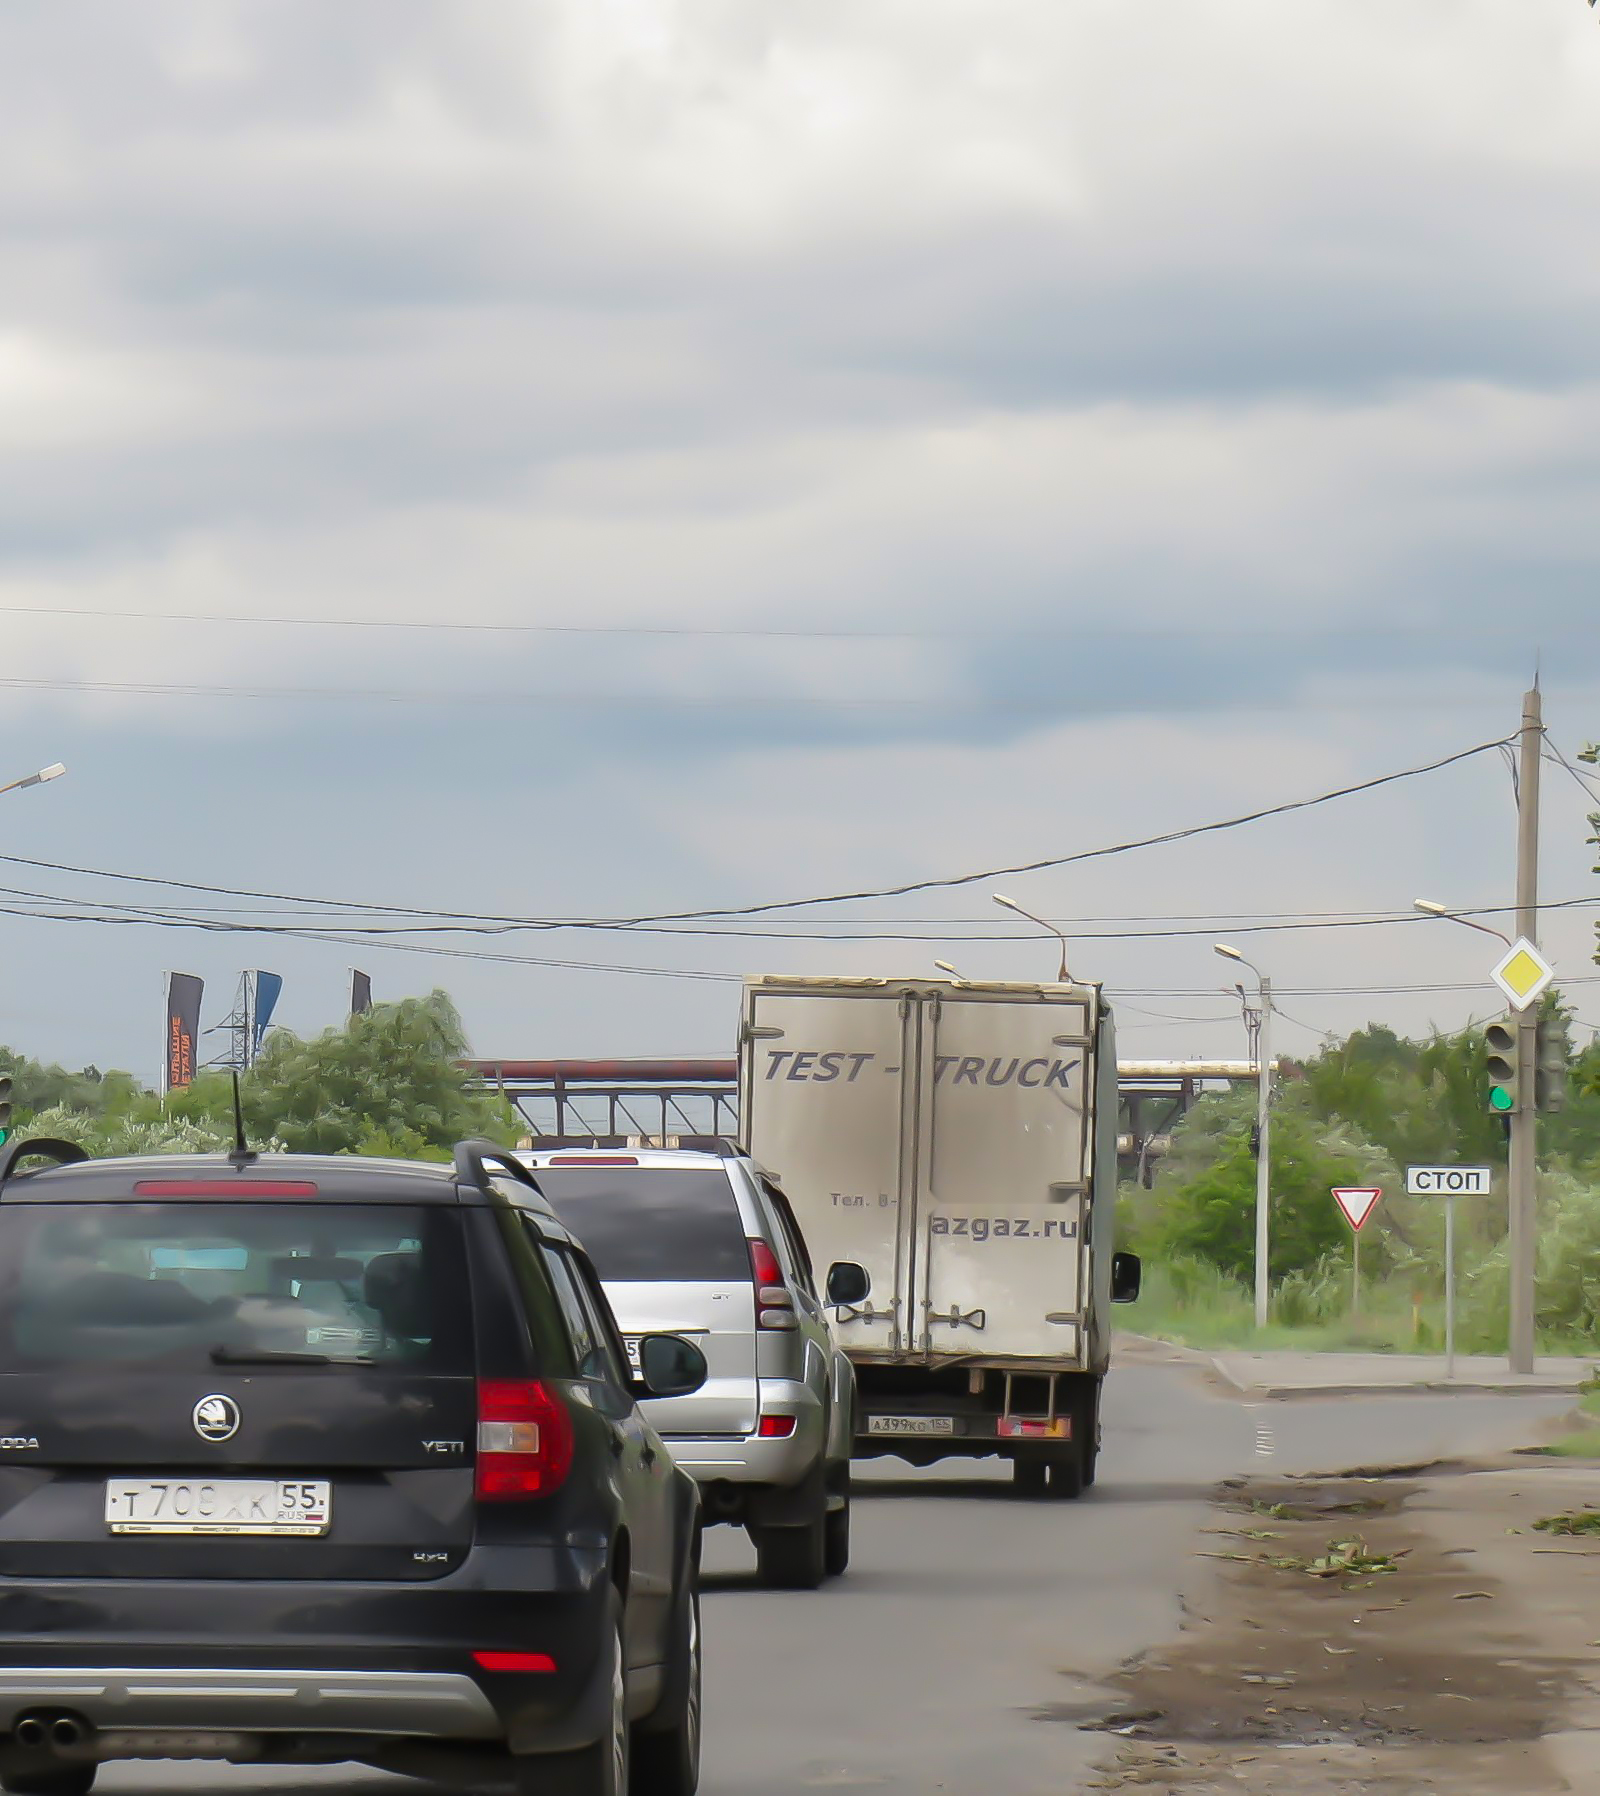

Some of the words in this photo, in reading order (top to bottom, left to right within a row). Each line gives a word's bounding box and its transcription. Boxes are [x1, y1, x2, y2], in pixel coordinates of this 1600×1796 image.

[765, 1050, 877, 1082] TEST
[934, 1056, 1082, 1089] TRUCK
[1416, 1171, 1481, 1191] СТОП
[421, 1440, 465, 1454] YETI
[282, 1484, 317, 1509] 55
